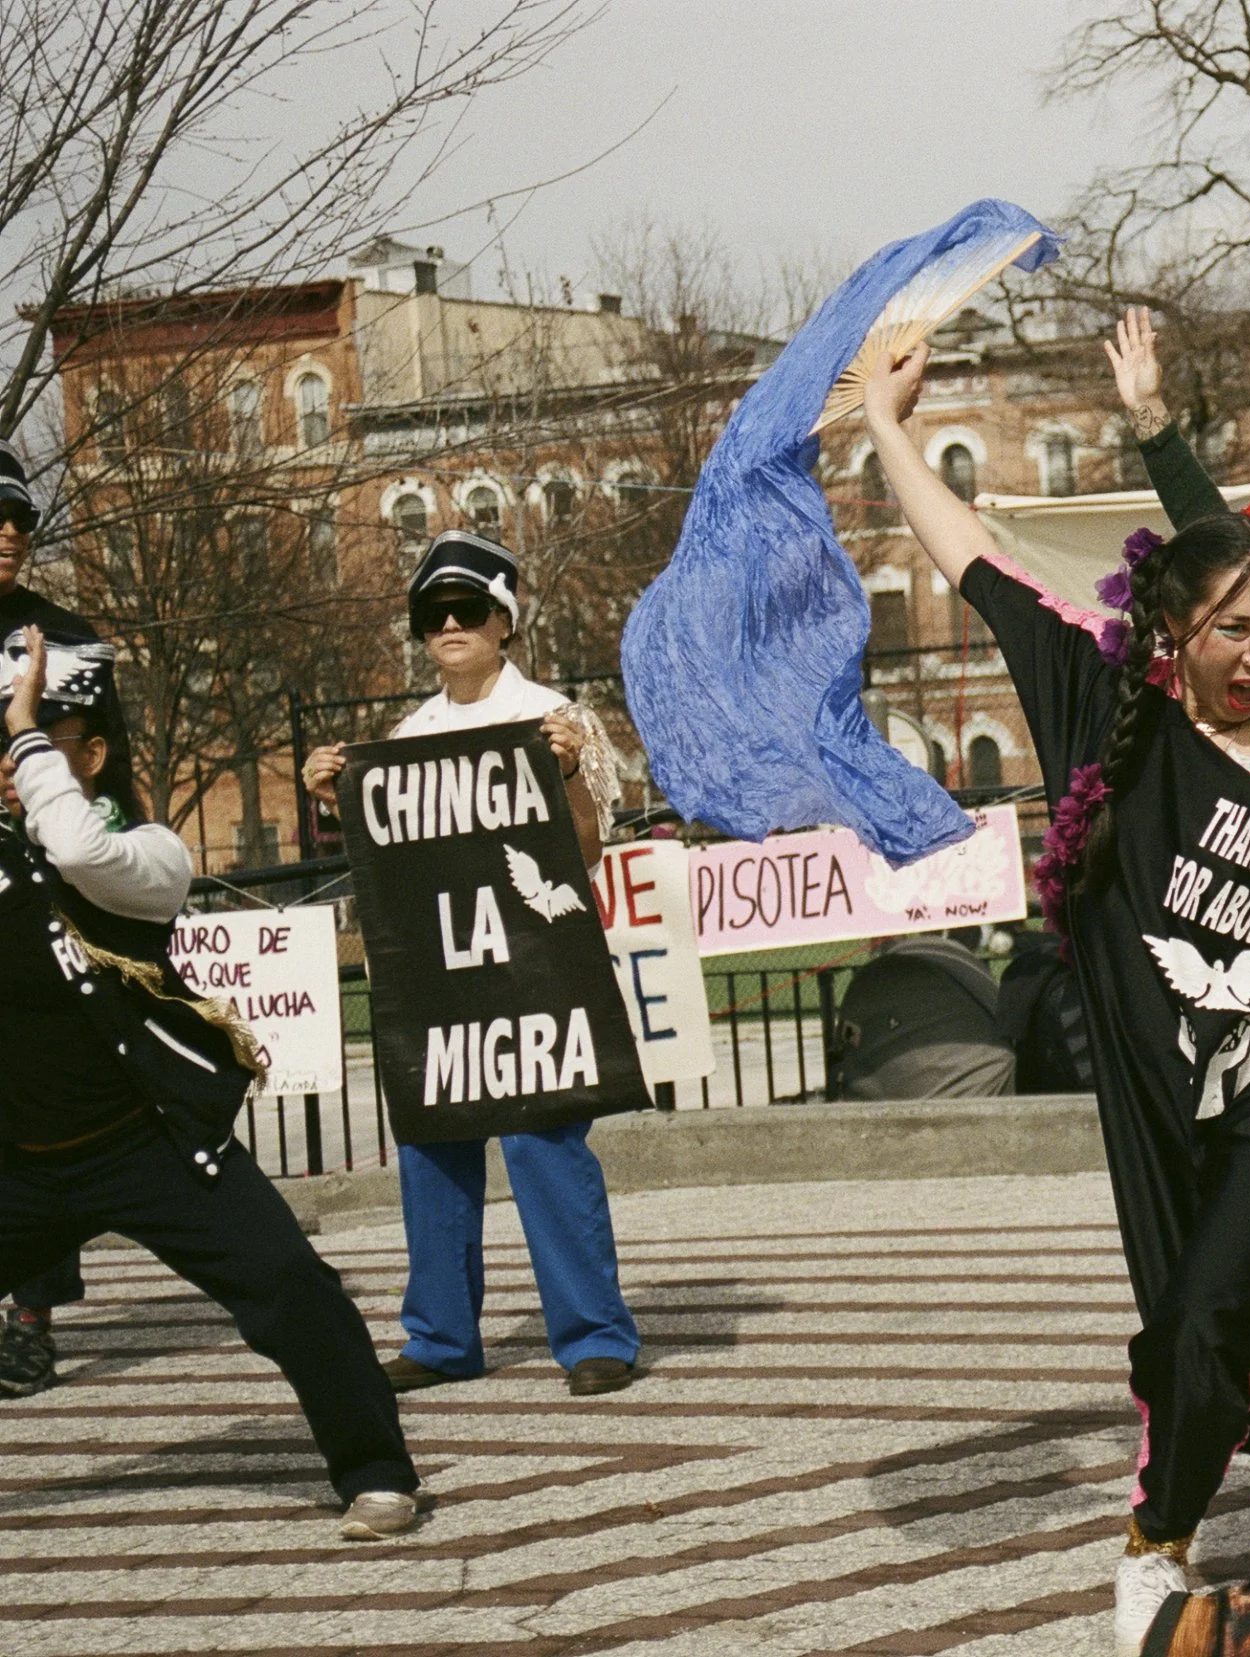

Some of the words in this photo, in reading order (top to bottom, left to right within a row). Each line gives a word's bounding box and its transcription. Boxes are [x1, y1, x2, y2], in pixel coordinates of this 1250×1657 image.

[362, 747, 550, 846] CHINGA
[697, 853, 853, 936] PISOTEA
[945, 901, 988, 917] NOW!
[1163, 855, 1213, 921] FOR
[168, 925, 231, 956] TURO
[258, 926, 291, 955] DE
[437, 885, 511, 971] LA
[209, 961, 252, 989] QUE
[248, 991, 315, 1021] LUCHA
[423, 1007, 599, 1107] MIGRA
